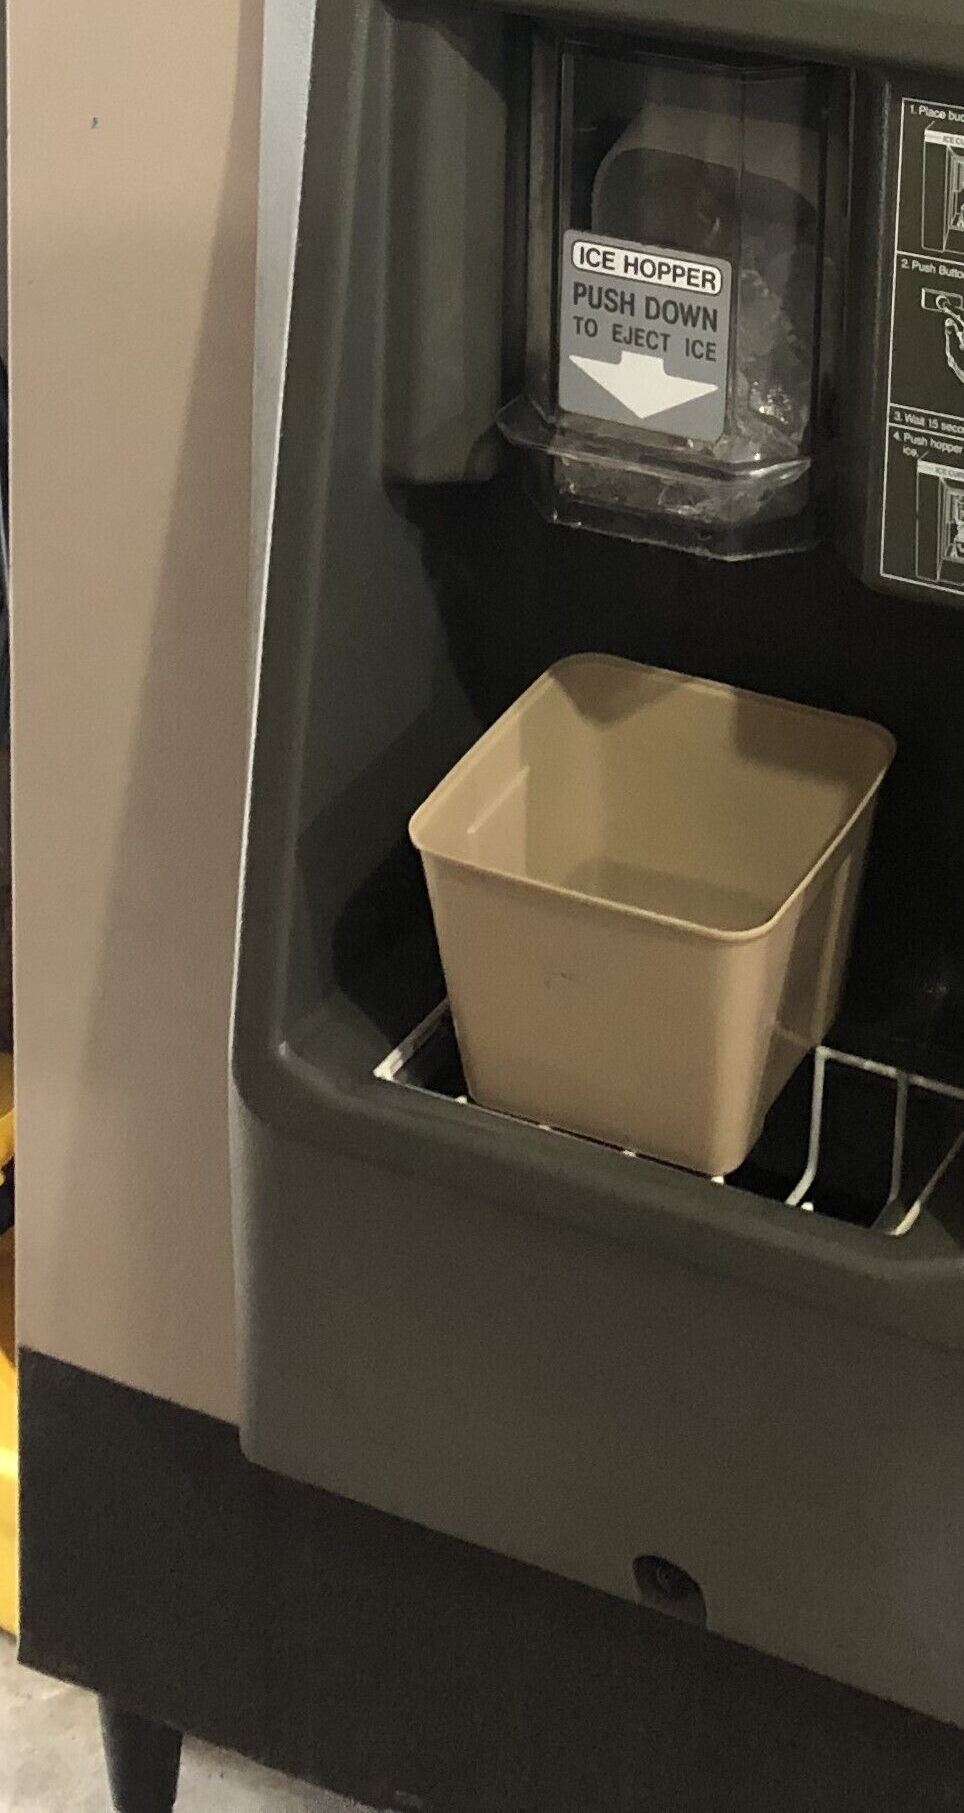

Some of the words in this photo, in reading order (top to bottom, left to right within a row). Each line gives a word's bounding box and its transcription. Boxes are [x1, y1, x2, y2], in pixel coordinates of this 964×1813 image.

[918, 105, 946, 120] Place
[579, 246, 615, 271] ICE
[623, 255, 716, 291] HOPPER
[912, 259, 936, 274] Push
[573, 281, 635, 317] PUSH
[644, 296, 718, 333] DOWN
[573, 315, 598, 338] TO
[612, 323, 671, 352] EJECT
[685, 338, 717, 363] ICE
[904, 412, 925, 427] Wait
[928, 417, 939, 429] 15
[903, 431, 928, 446] Push
[930, 438, 963, 454] hopper
